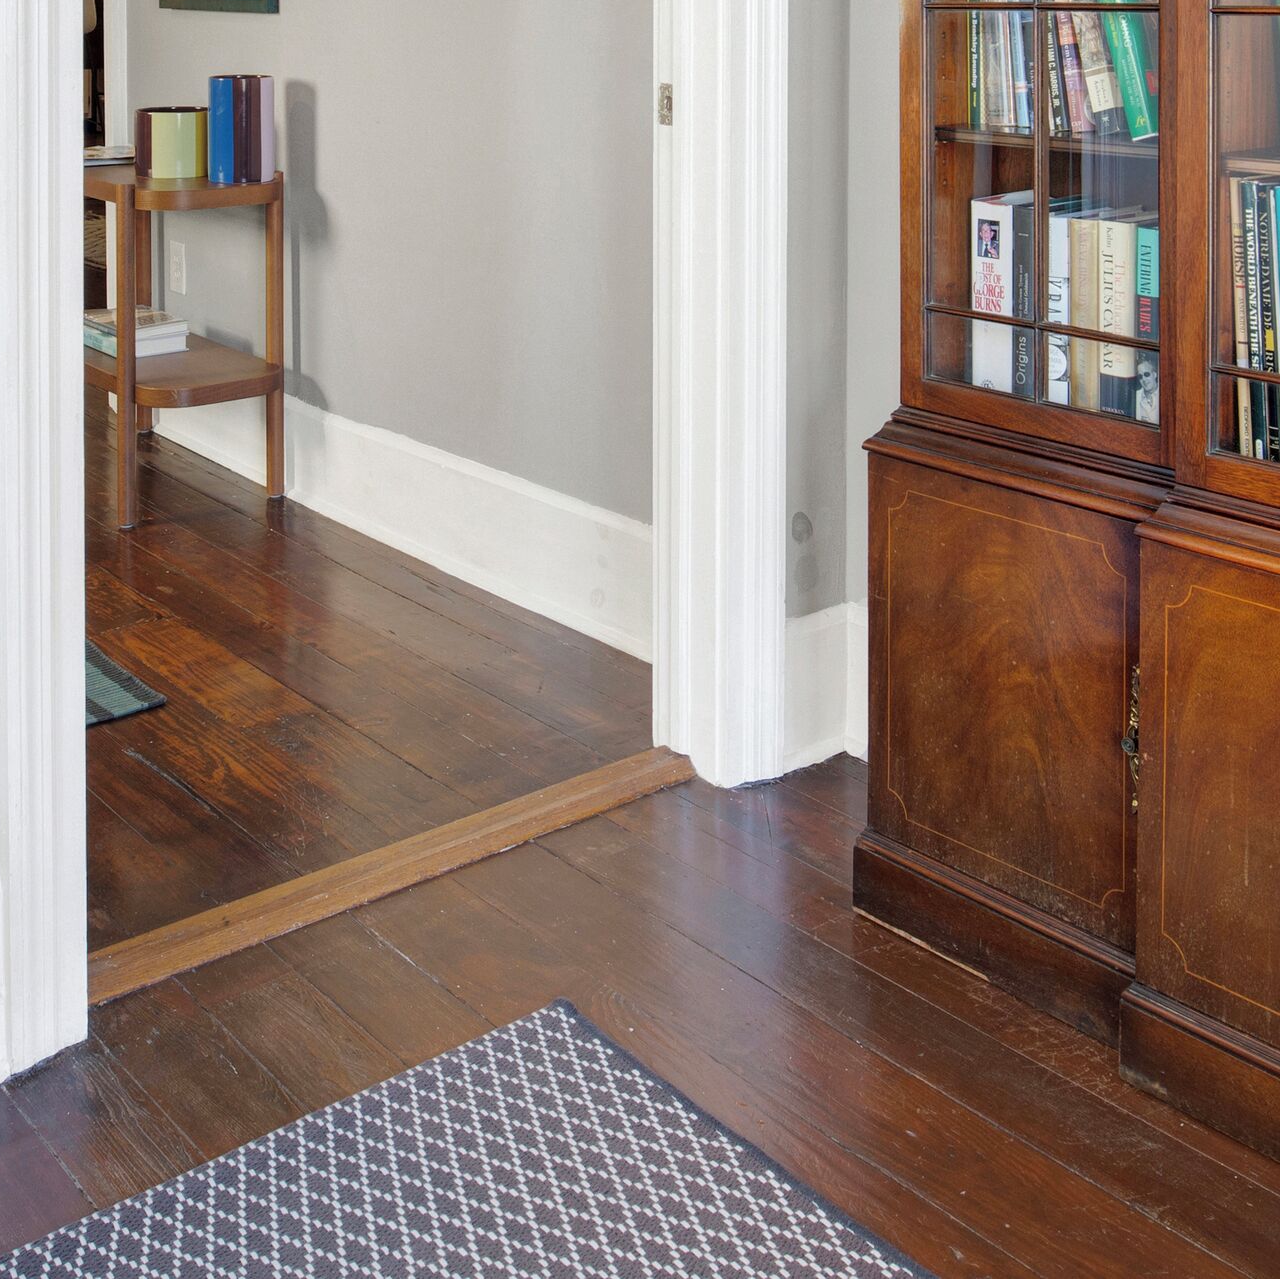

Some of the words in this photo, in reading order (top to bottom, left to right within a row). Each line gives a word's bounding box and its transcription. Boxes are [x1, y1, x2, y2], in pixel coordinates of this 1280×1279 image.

[970, 18, 979, 53] Benchley
[1048, 25, 1056, 63] WILLIAM
[970, 53, 978, 89] Roundup
[1050, 72, 1059, 99] HARRIS,
[1244, 207, 1254, 227] THE
[981, 261, 995, 274] THE
[1233, 233, 1244, 282] HORSE
[1245, 227, 1256, 275] WORLD
[992, 274, 1002, 285] OF
[1101, 250, 1115, 306] JULIUS
[1114, 260, 1126, 285] The
[1139, 244, 1153, 296] ENTERING
[973, 297, 1002, 313] BURNS
[1139, 296, 1152, 334] HADES
[1247, 275, 1258, 329] BENEATH
[1248, 329, 1258, 351] THE
[1015, 335, 1029, 385] Origins
